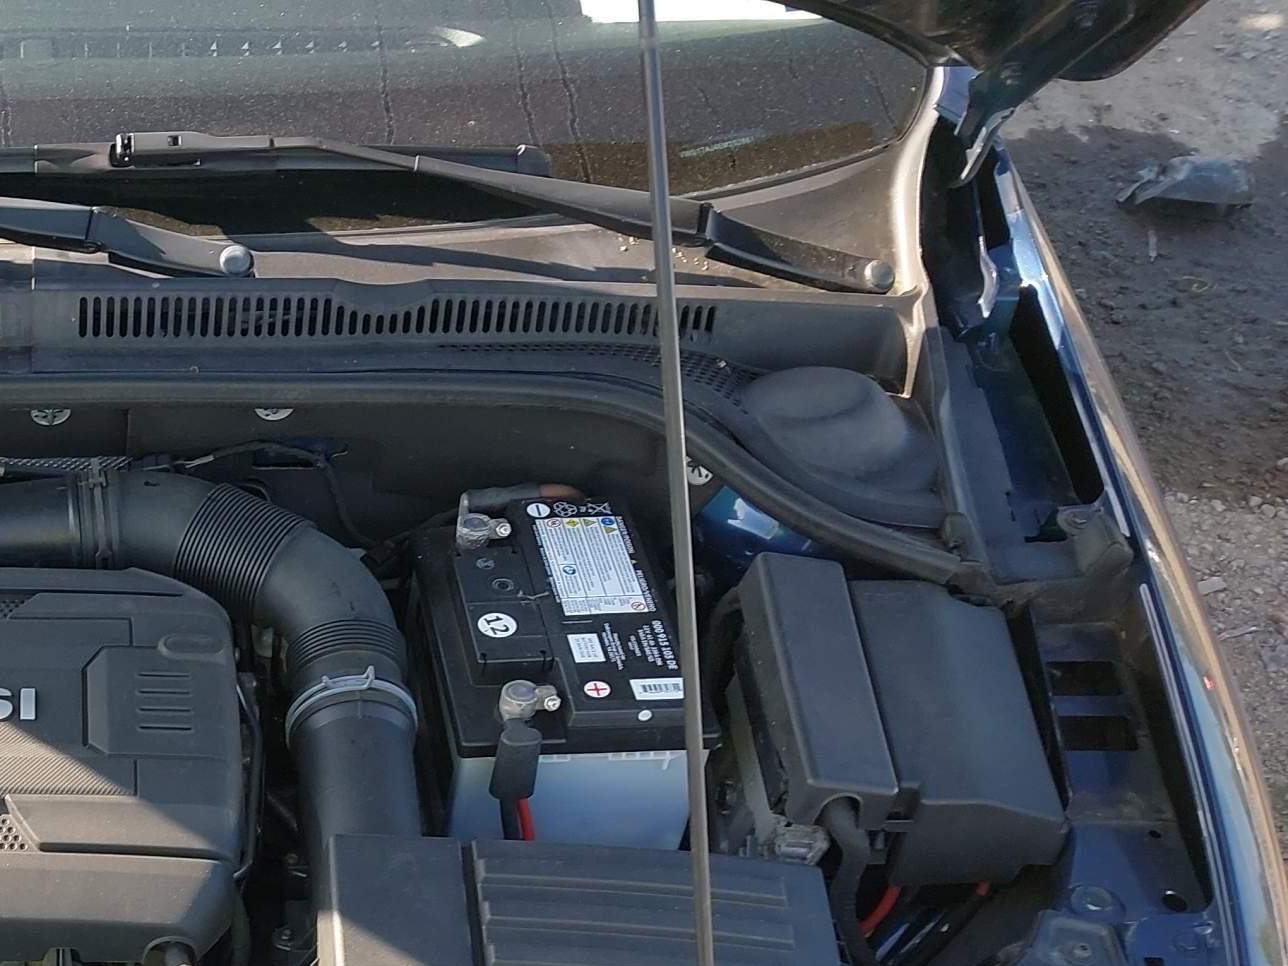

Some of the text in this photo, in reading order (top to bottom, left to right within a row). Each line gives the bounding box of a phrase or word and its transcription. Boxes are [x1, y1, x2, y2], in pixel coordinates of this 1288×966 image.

[484, 615, 510, 635] 12
[652, 620, 664, 633] 000
[657, 634, 669, 646] 915
